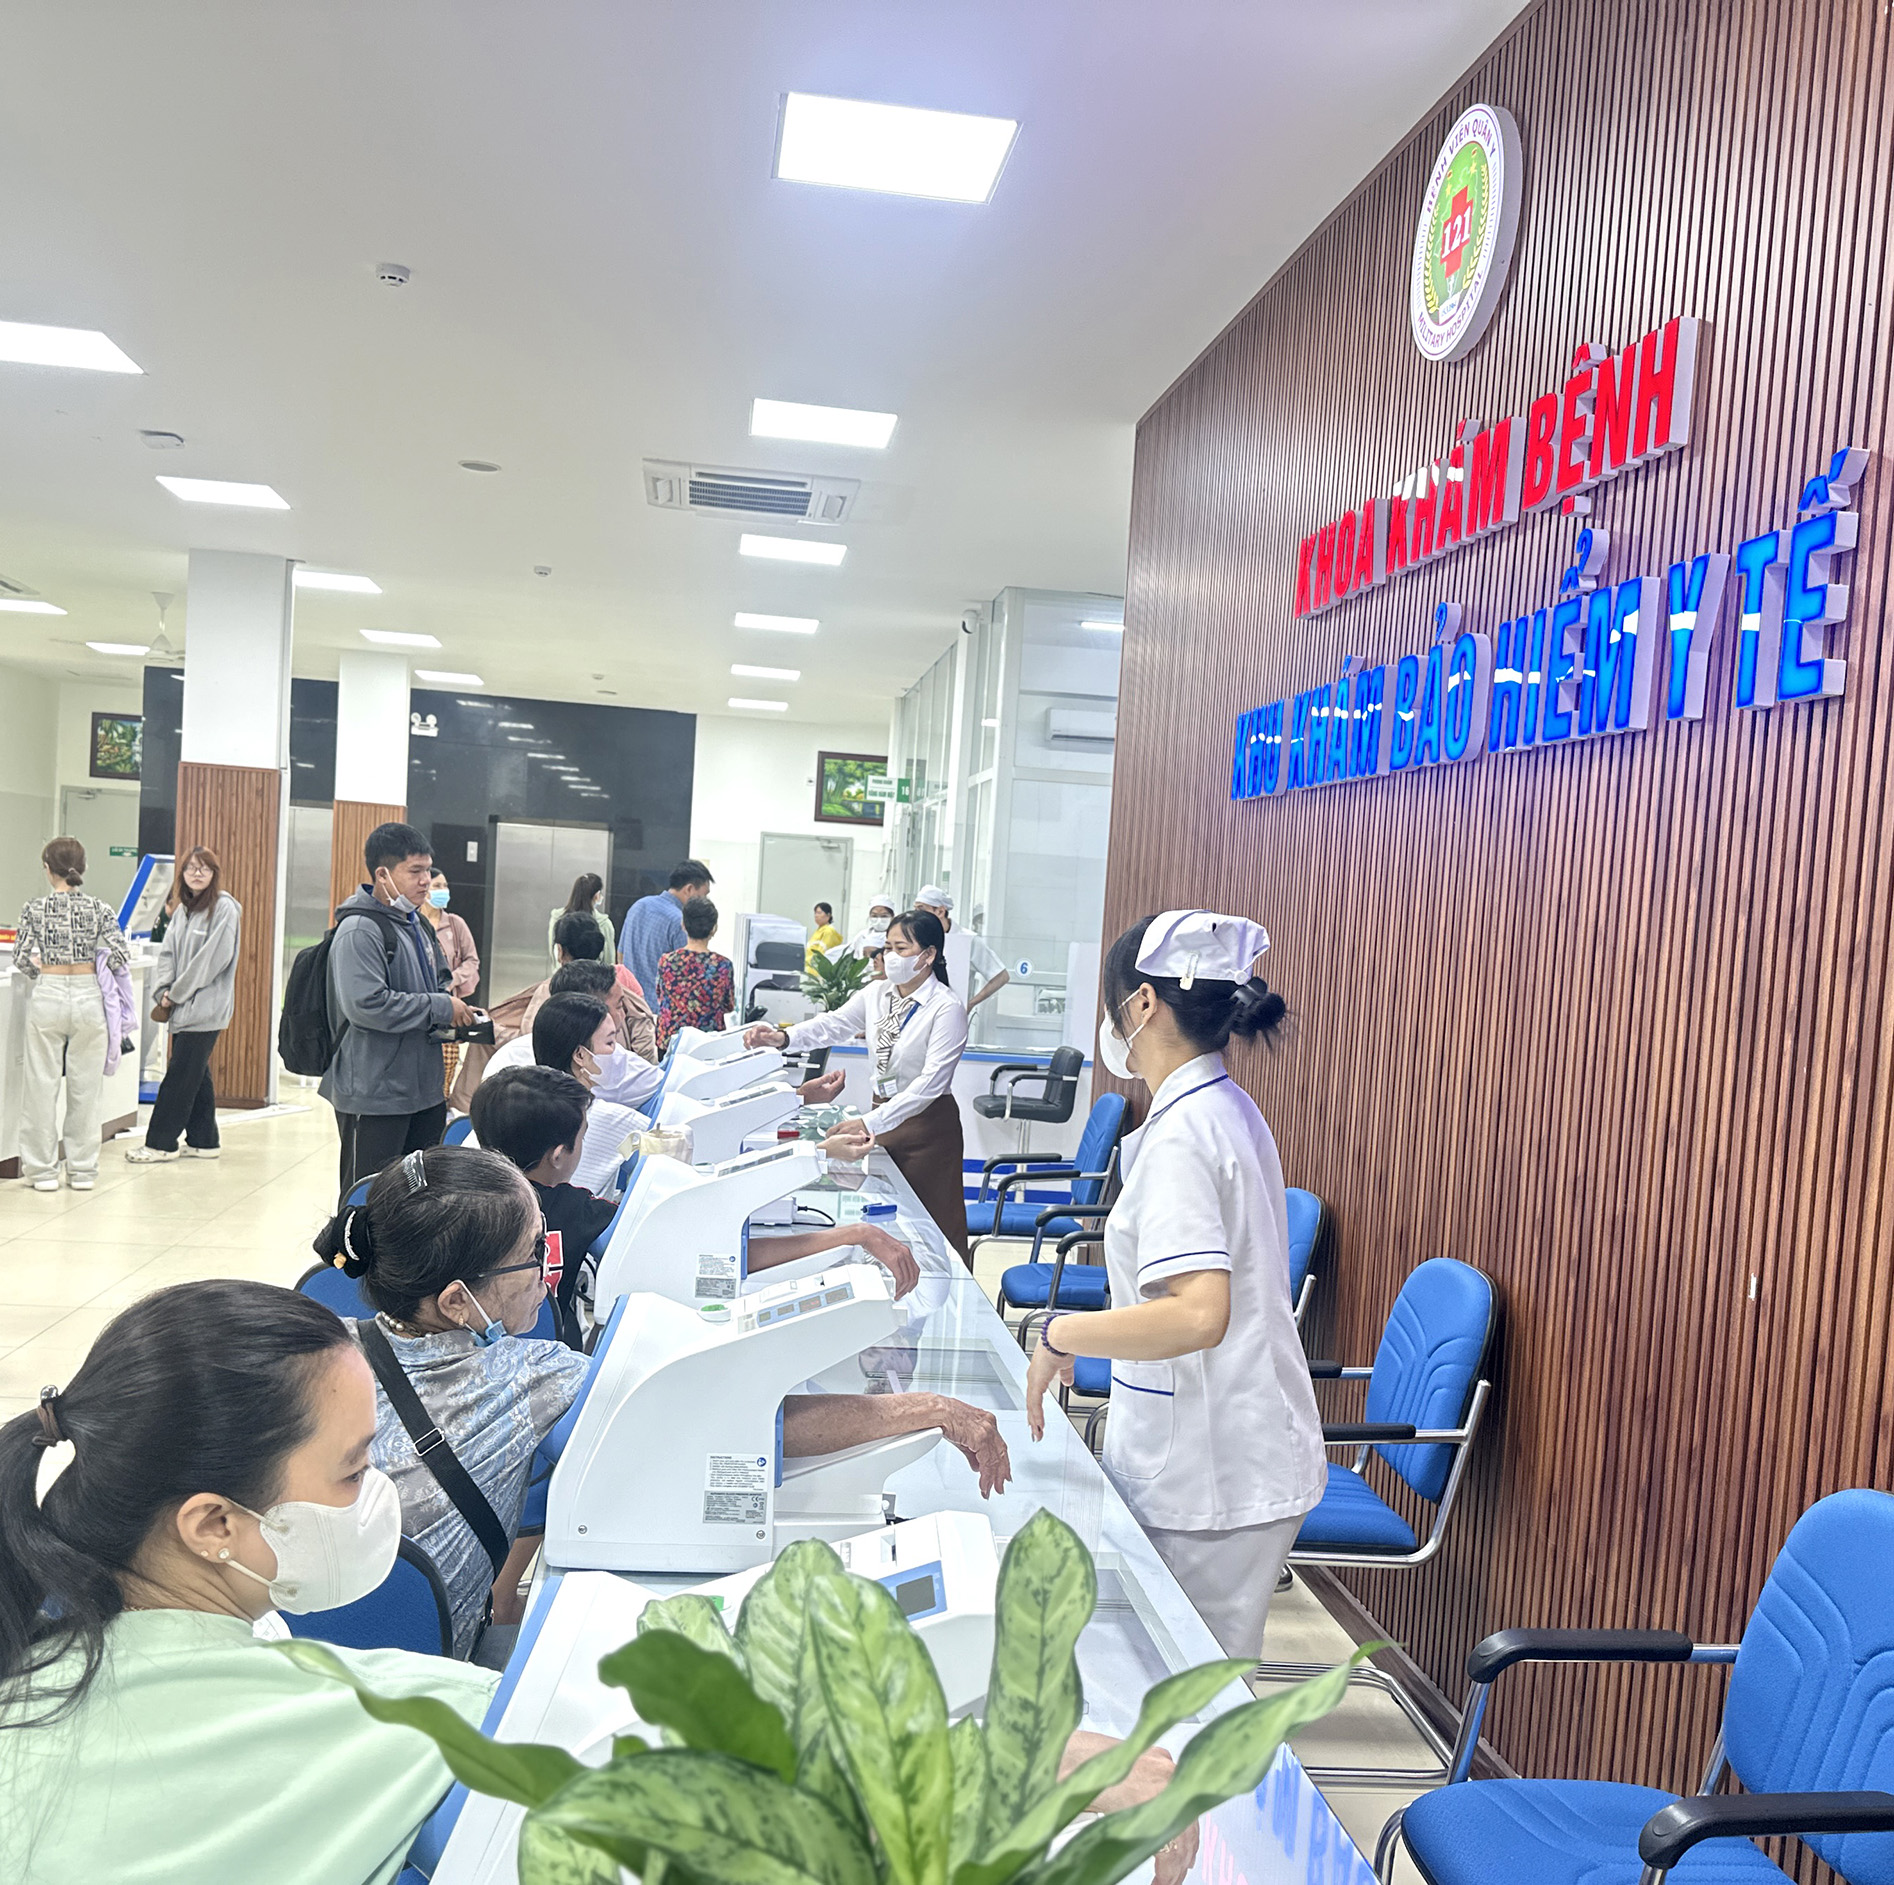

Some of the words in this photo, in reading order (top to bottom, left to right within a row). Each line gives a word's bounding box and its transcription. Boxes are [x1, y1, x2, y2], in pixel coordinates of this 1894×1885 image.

[1449, 121, 1471, 156] VIỆN
[1472, 118, 1493, 147] QUÂN
[1489, 141, 1497, 158] Y
[1441, 206, 1472, 259] 121
[1417, 311, 1446, 348] MILITARY
[1445, 271, 1483, 343] HOSPITAL
[1295, 499, 1378, 619] KHOA
[1386, 416, 1514, 574] KHÁM
[1522, 316, 1684, 517] BỆNH
[1231, 699, 1286, 801] KHU
[1287, 655, 1386, 791] KHÁM
[1390, 602, 1478, 771] BẢO
[1488, 528, 1644, 753] HIỂM
[1667, 552, 1712, 721] Y
[1735, 445, 1852, 710] TẾ
[1020, 962, 1028, 974] 6
